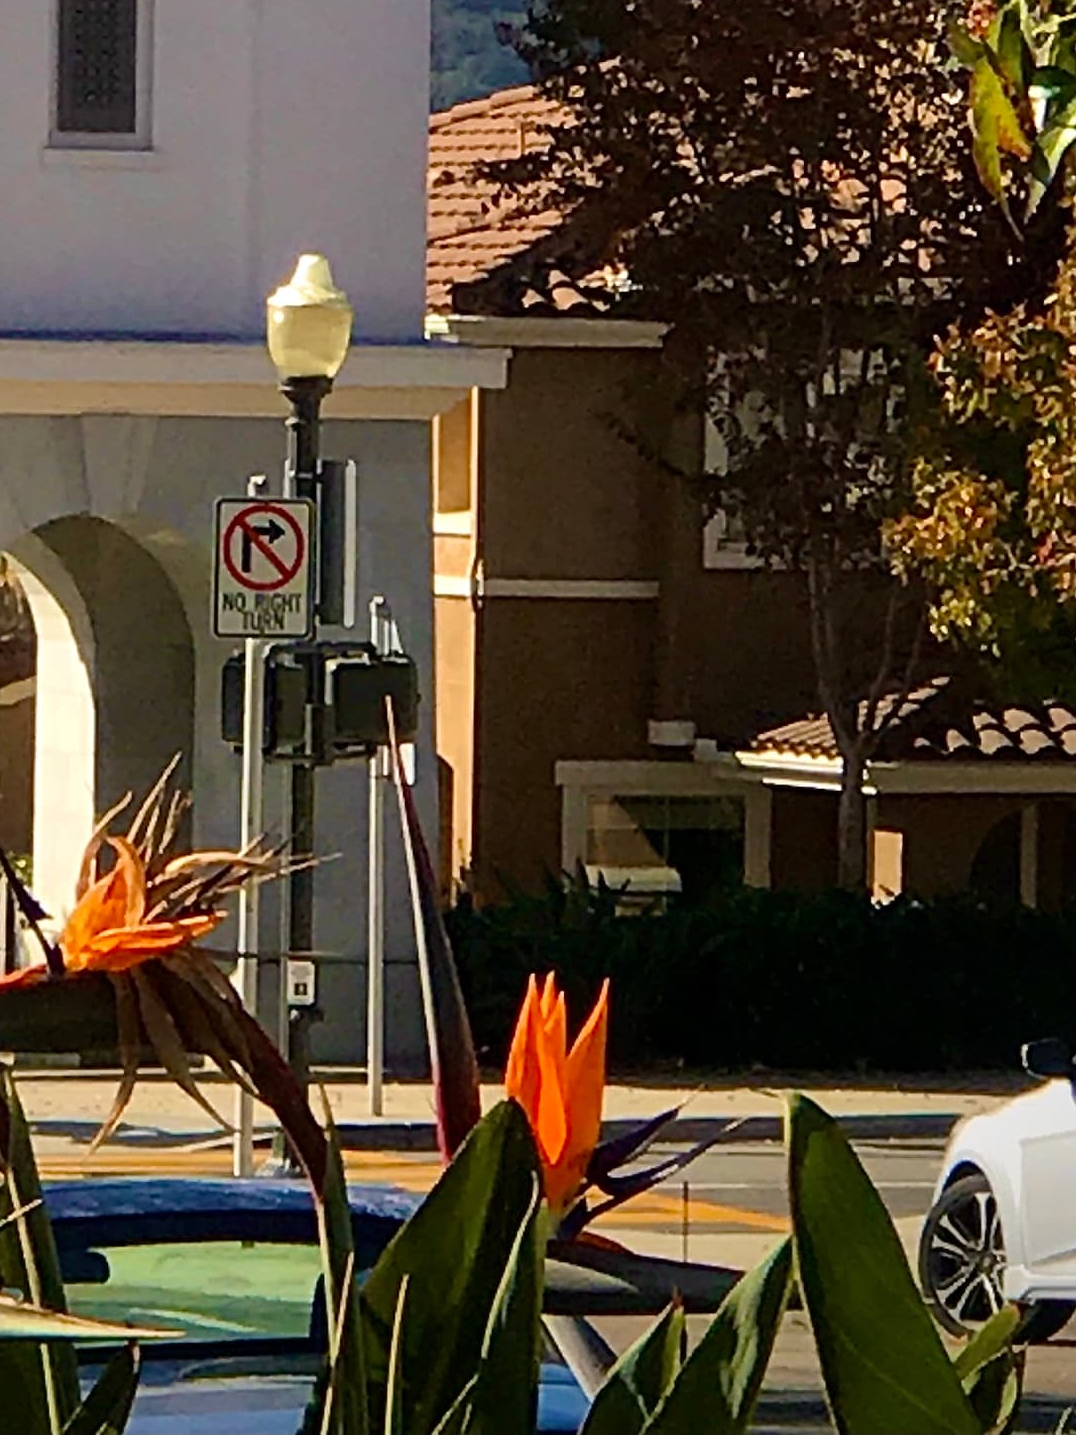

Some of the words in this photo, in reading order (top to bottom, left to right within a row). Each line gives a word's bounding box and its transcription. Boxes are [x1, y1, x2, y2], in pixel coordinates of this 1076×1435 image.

[222, 593, 246, 612] NO
[255, 594, 301, 612] RIGHT
[242, 612, 284, 630] TURN
